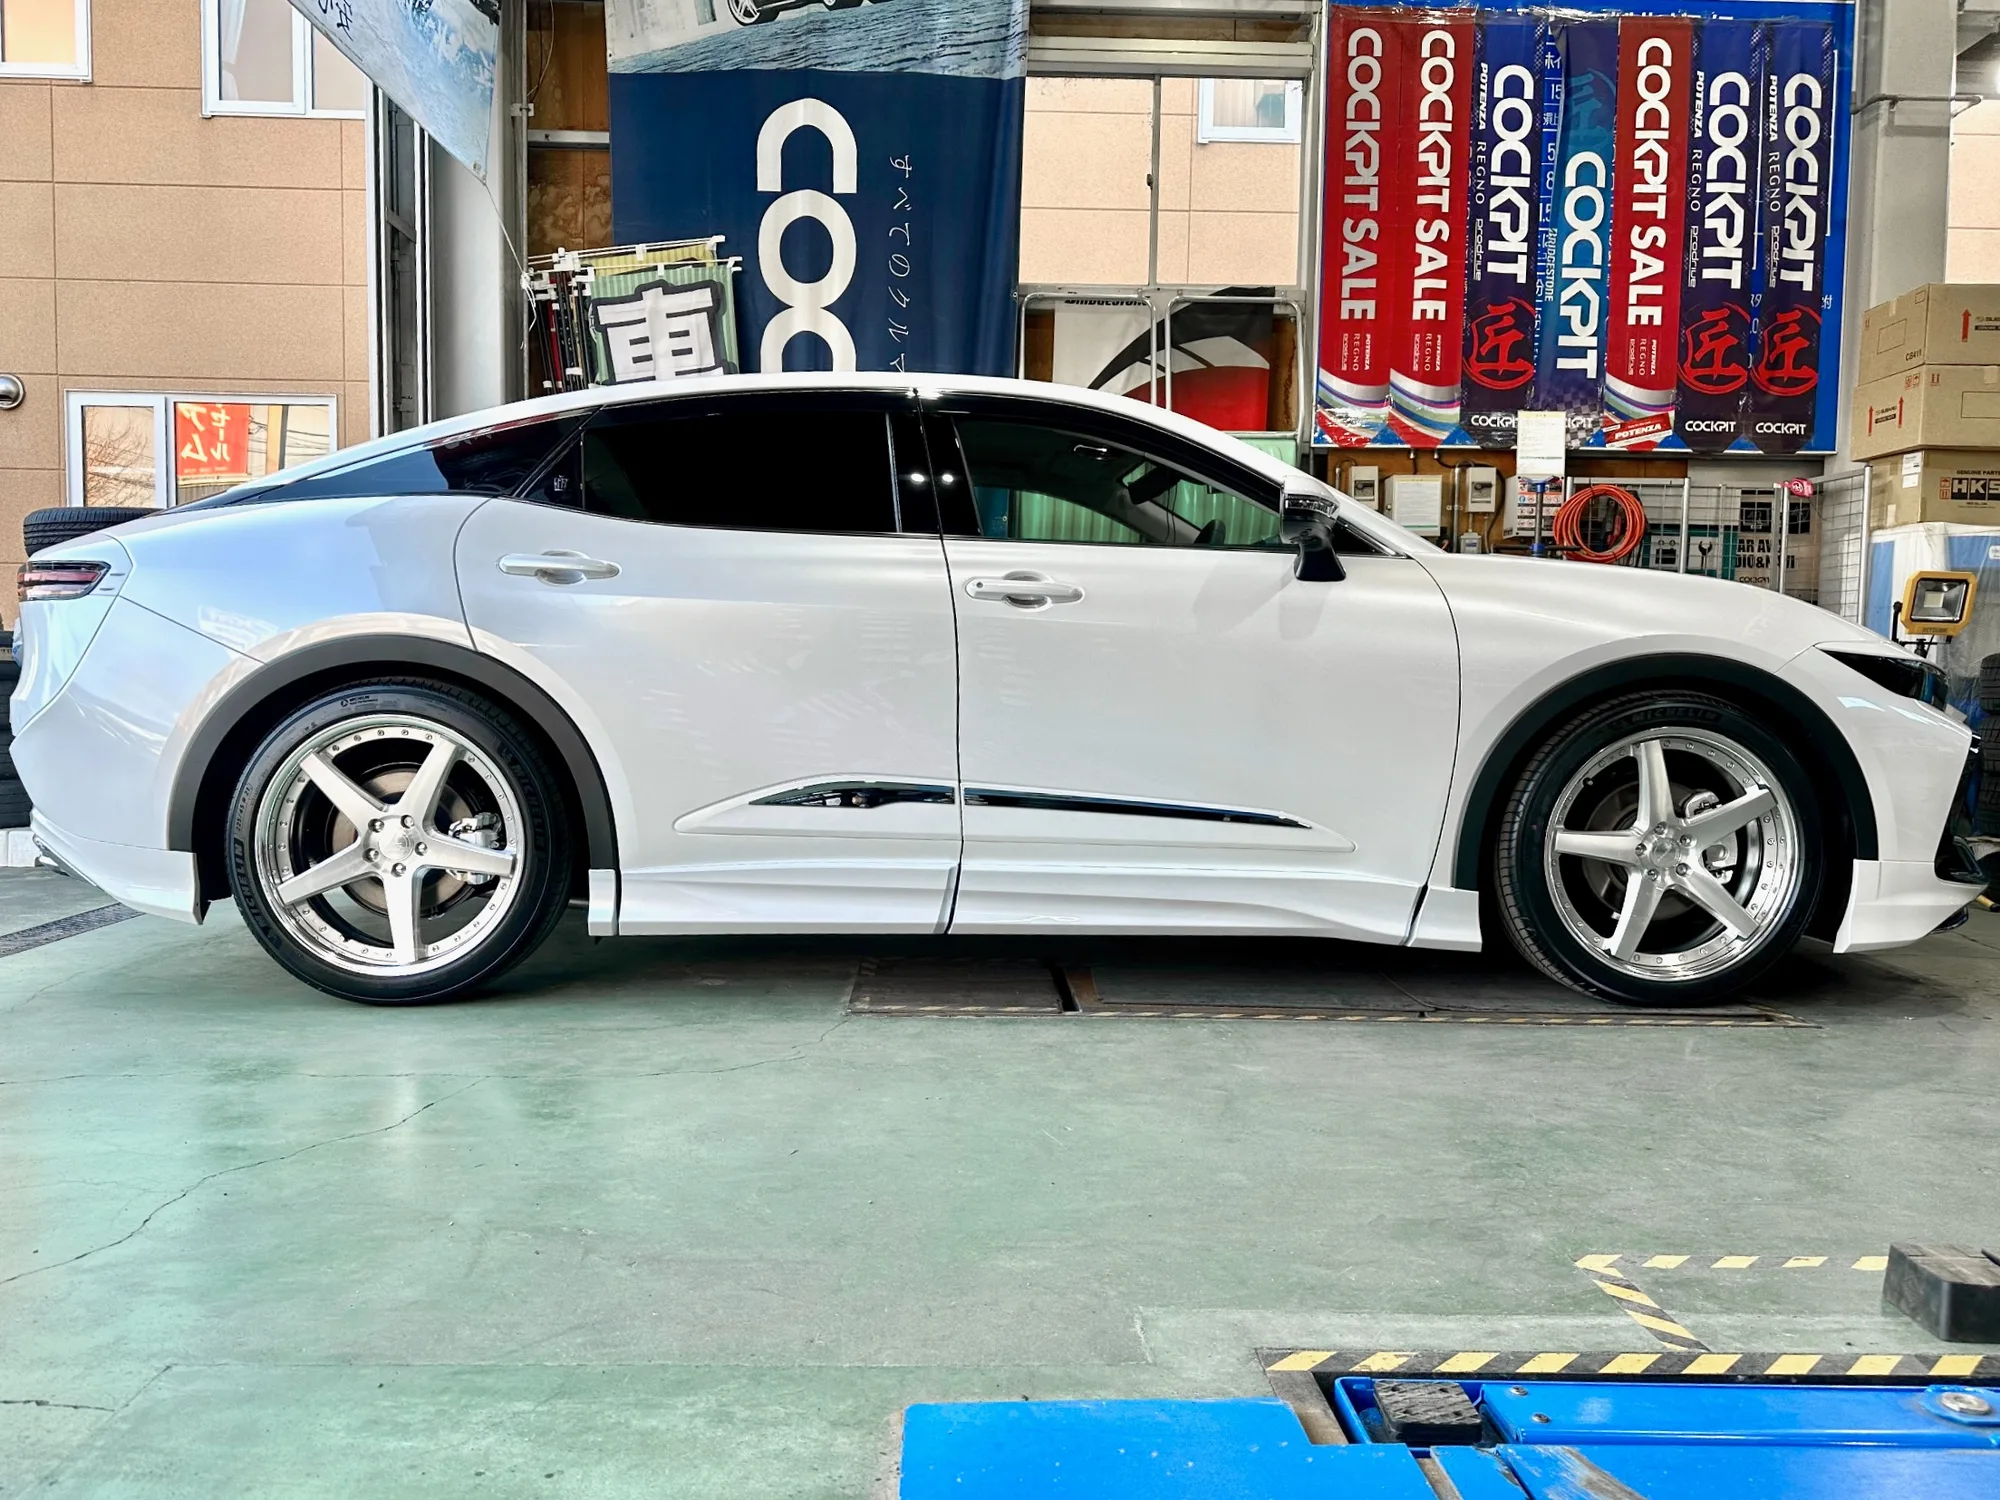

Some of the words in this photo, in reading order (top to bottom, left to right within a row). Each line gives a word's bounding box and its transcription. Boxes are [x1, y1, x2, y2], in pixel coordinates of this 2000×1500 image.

[1344, 27, 1383, 212] COCKPIT
[1416, 29, 1455, 213] COCKPIT
[1478, 62, 1489, 130] POTENZA
[1632, 37, 1673, 220] COCKPIT
[1694, 70, 1705, 138] POTENZA
[1769, 74, 1778, 142] POTENZA
[1475, 141, 1487, 205] REGNO
[1487, 64, 1534, 284] COCKPIT
[1690, 149, 1703, 212] REGNO
[1702, 71, 1750, 289] COCKPIT
[1768, 151, 1780, 212] REGNO
[1780, 72, 1822, 291] COCKPIT
[1340, 217, 1379, 320] SALE
[1412, 217, 1450, 321] SALE
[1556, 151, 1607, 379] COCKPIT
[1627, 224, 1667, 326] SALE
[1352, 333, 1360, 371] REGNO
[1424, 333, 1432, 371] REGNO
[1639, 339, 1647, 376] REGNO
[1614, 423, 1662, 440] POTENZA
[1685, 420, 1736, 433] COCKPIT
[1755, 422, 1807, 435] COCKPIT
[234, 843, 267, 927] MICHELIN
